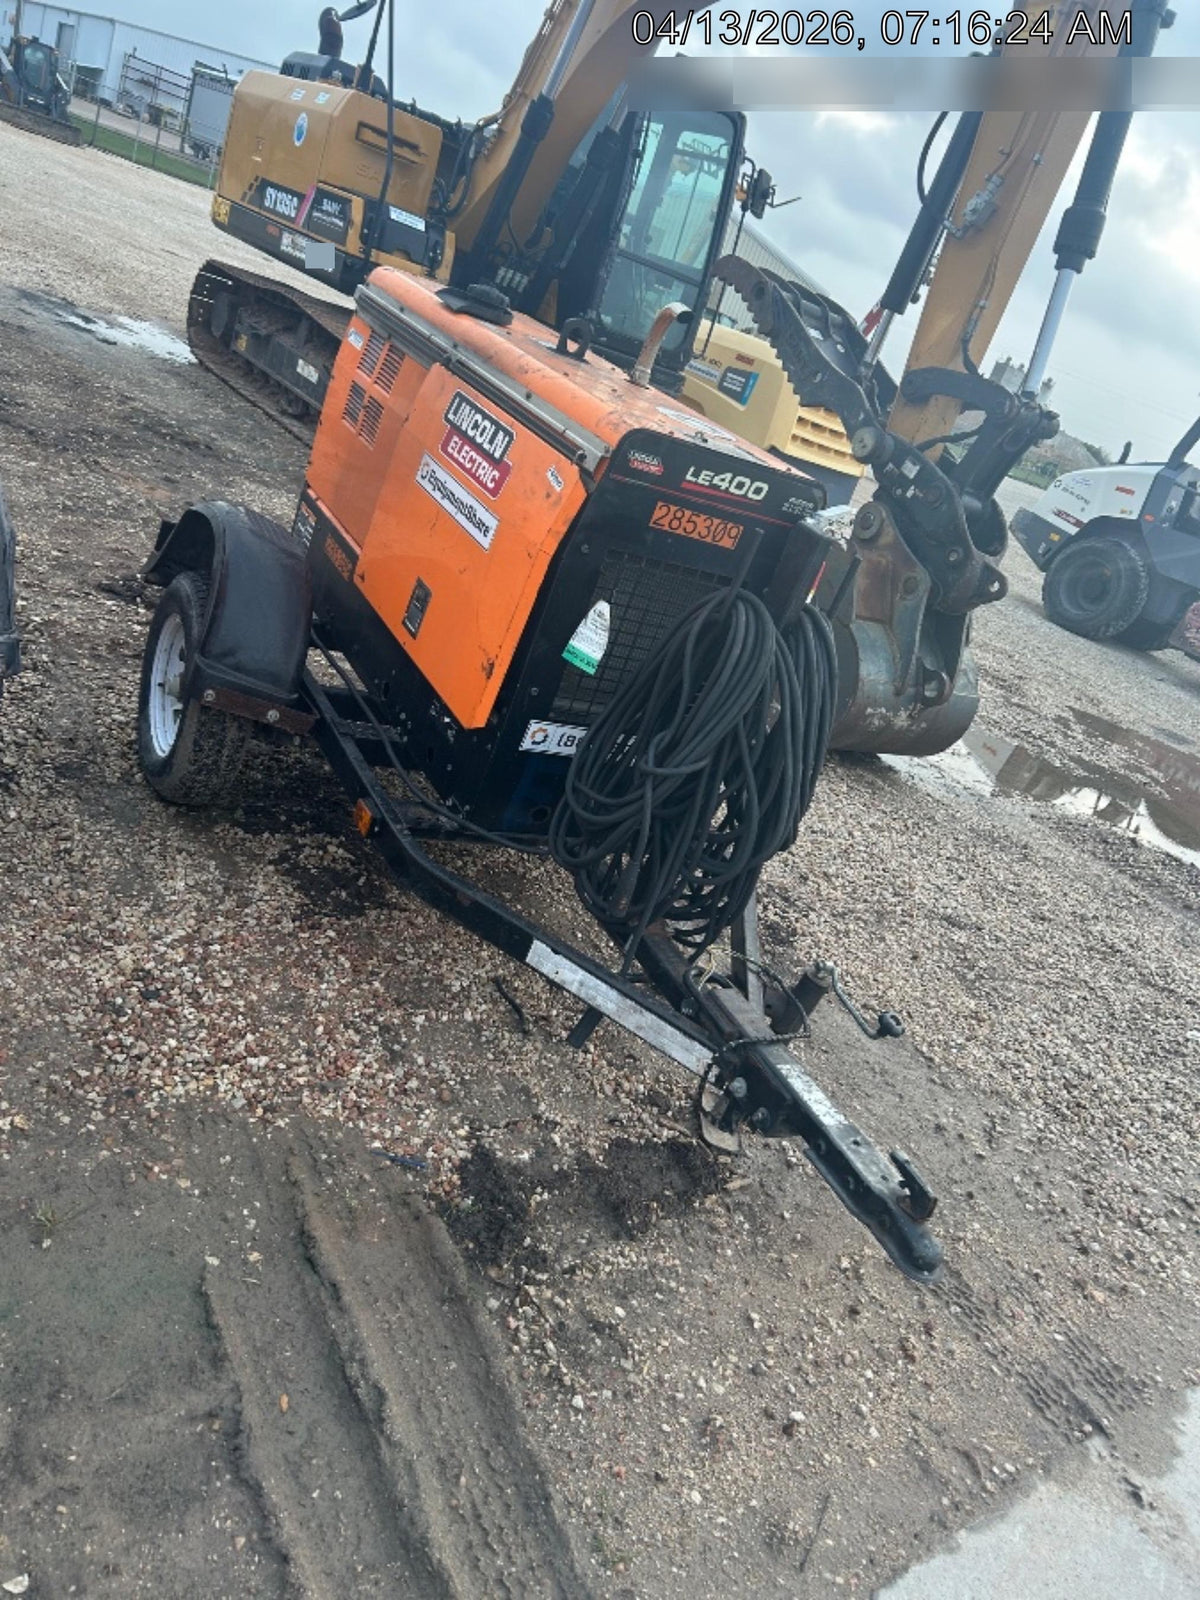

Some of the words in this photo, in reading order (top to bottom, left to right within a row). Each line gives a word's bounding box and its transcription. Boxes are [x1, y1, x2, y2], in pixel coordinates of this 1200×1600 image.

[447, 396, 510, 460] LINCOLN
[447, 435, 501, 489] ELECTRIC
[684, 465, 769, 501] LE400
[652, 504, 741, 547] 285309
